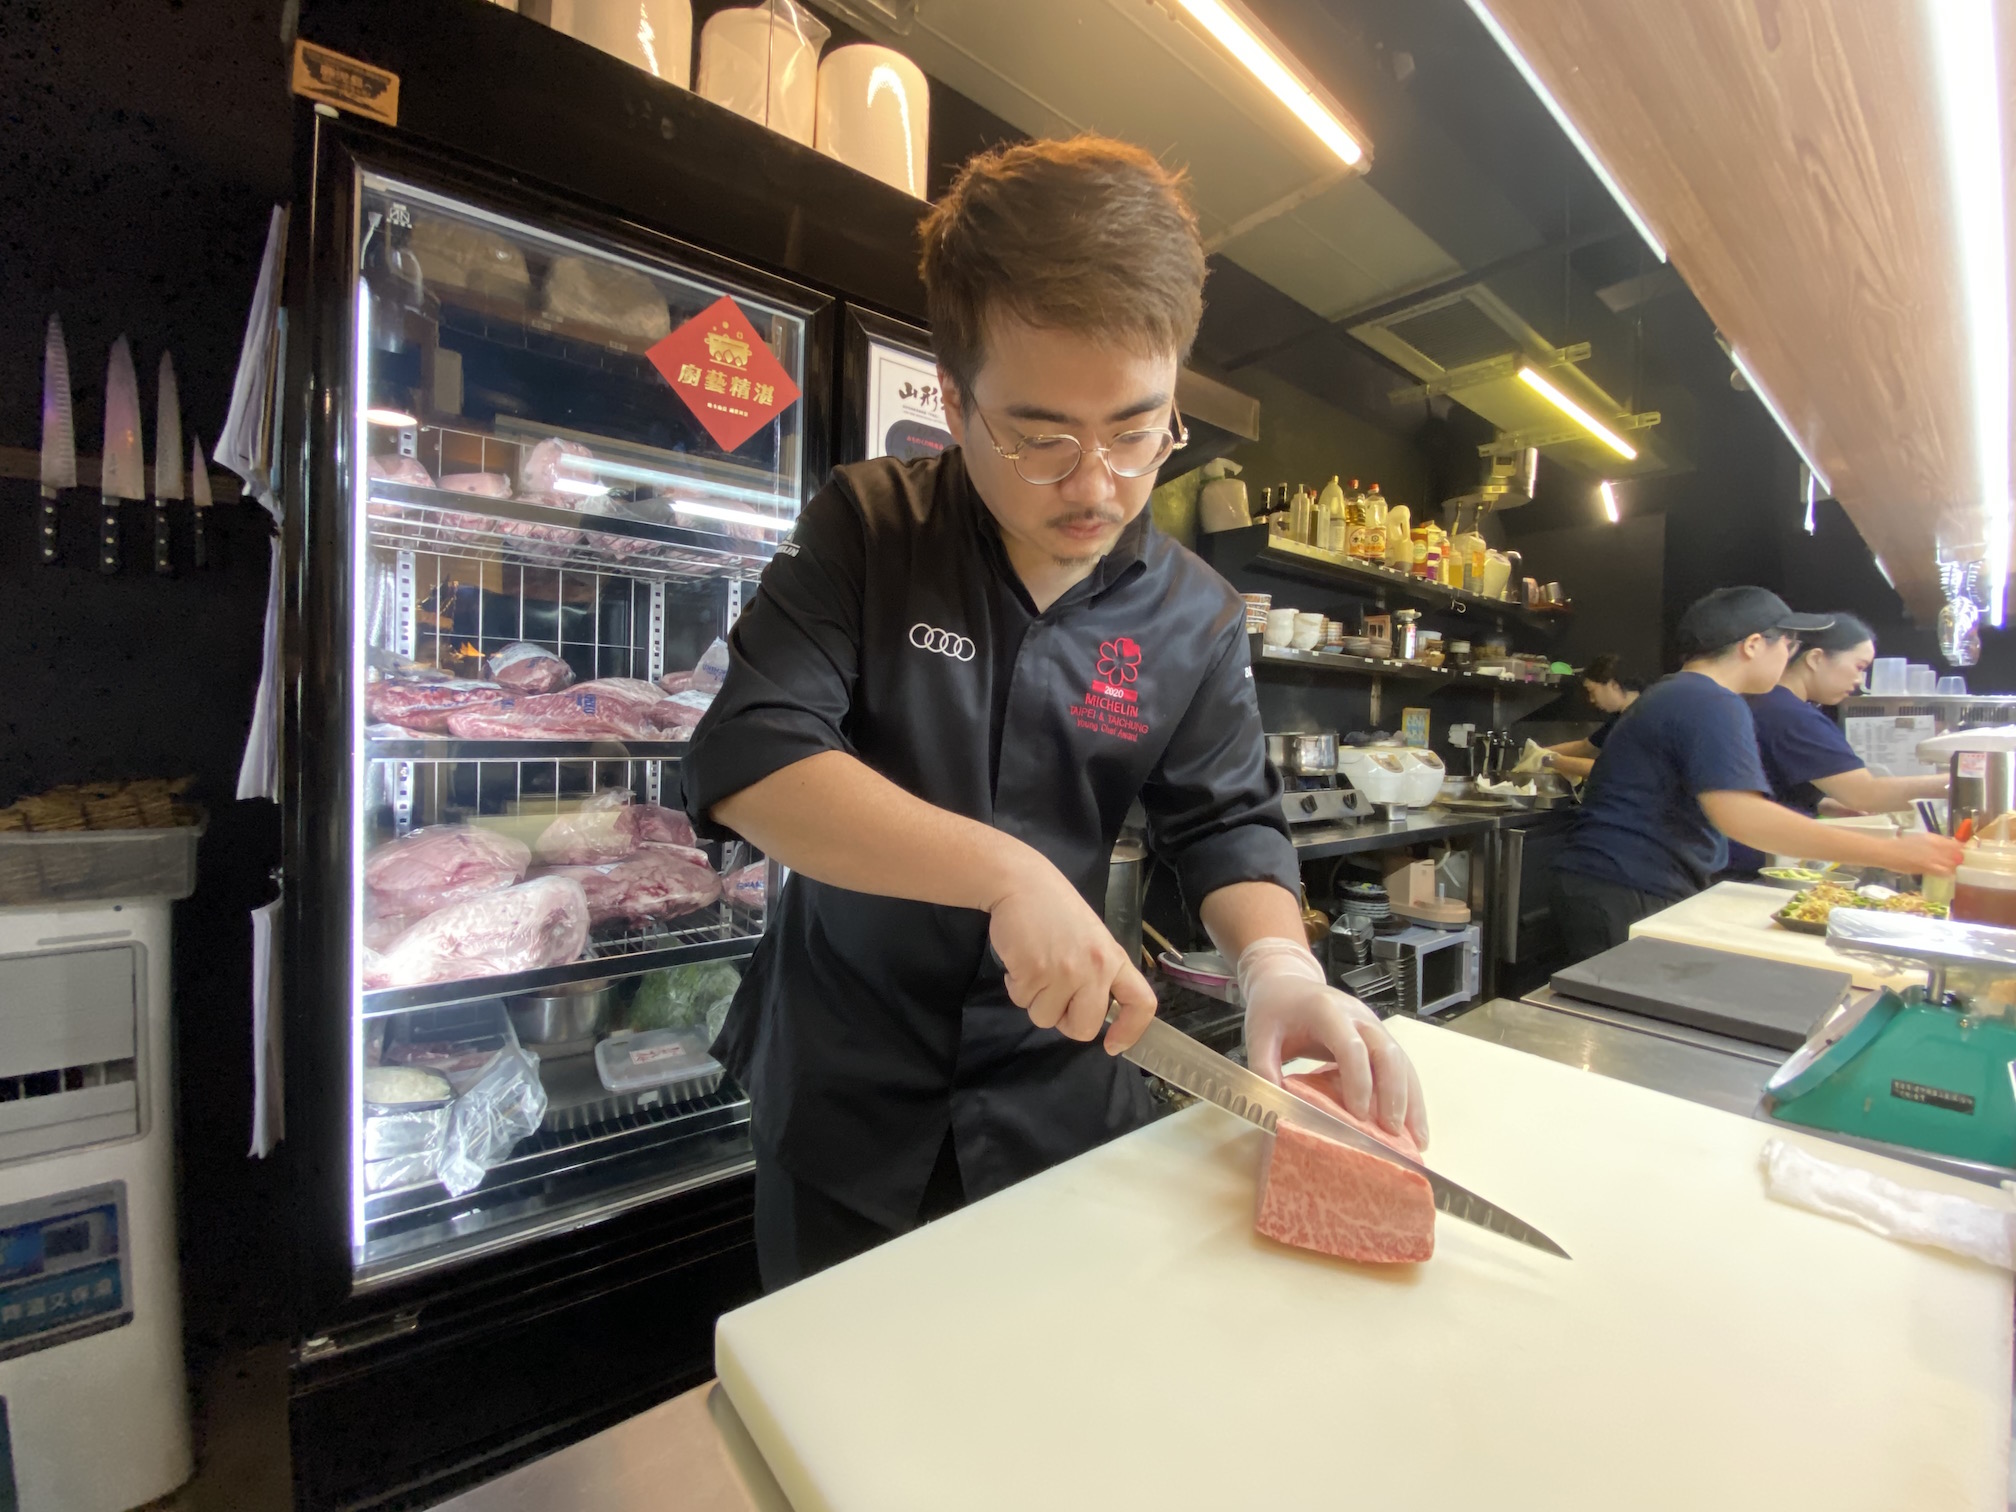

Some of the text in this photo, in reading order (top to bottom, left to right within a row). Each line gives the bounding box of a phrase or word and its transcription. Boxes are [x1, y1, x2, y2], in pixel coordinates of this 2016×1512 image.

[678, 363, 775, 406] 廚藝精湛
[899, 382, 945, 412] 山形
[1085, 693, 1139, 718] MICHELIN
[1104, 685, 1125, 699] 2020
[1070, 705, 1149, 734] TAIPEI & TAICHUNG
[1077, 718, 1139, 743] Young Chef Award
